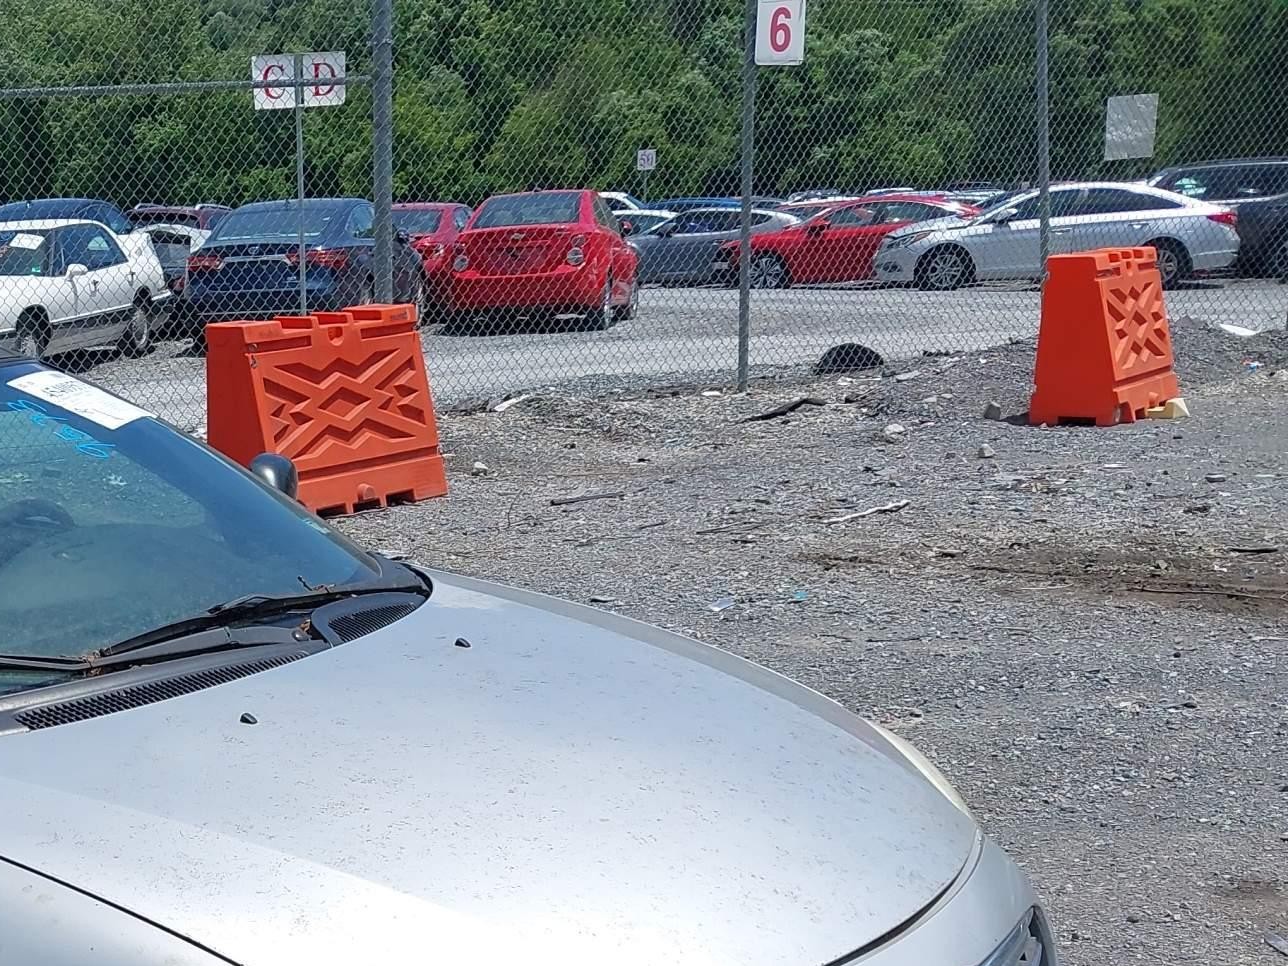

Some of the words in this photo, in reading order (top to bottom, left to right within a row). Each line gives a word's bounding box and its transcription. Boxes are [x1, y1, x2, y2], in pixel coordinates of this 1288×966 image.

[770, 6, 792, 53] 6
[262, 63, 285, 100] C
[312, 61, 337, 97] D
